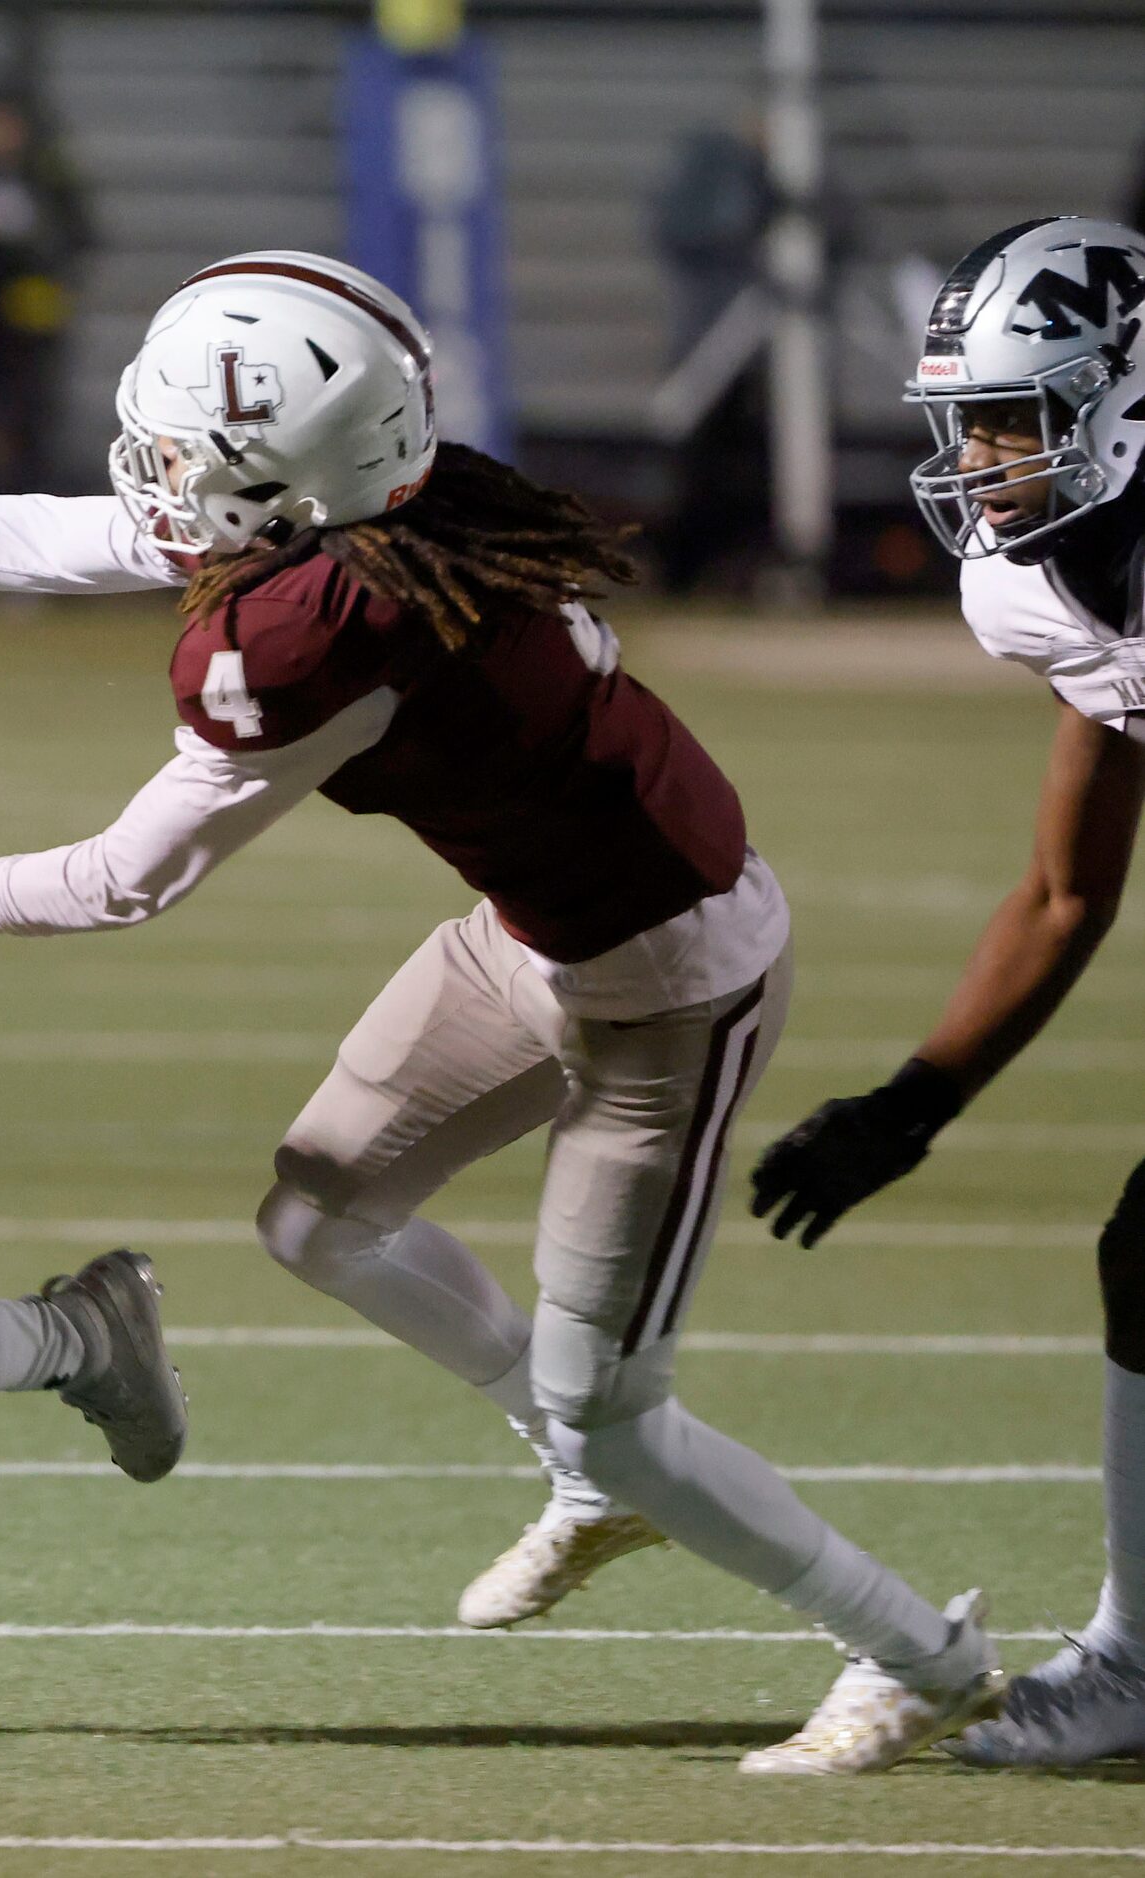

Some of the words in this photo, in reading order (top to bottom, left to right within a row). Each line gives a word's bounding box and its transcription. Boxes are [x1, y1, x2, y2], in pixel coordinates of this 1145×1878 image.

[1016, 245, 1145, 341] M
[215, 346, 276, 427] L
[201, 650, 264, 739] 4
